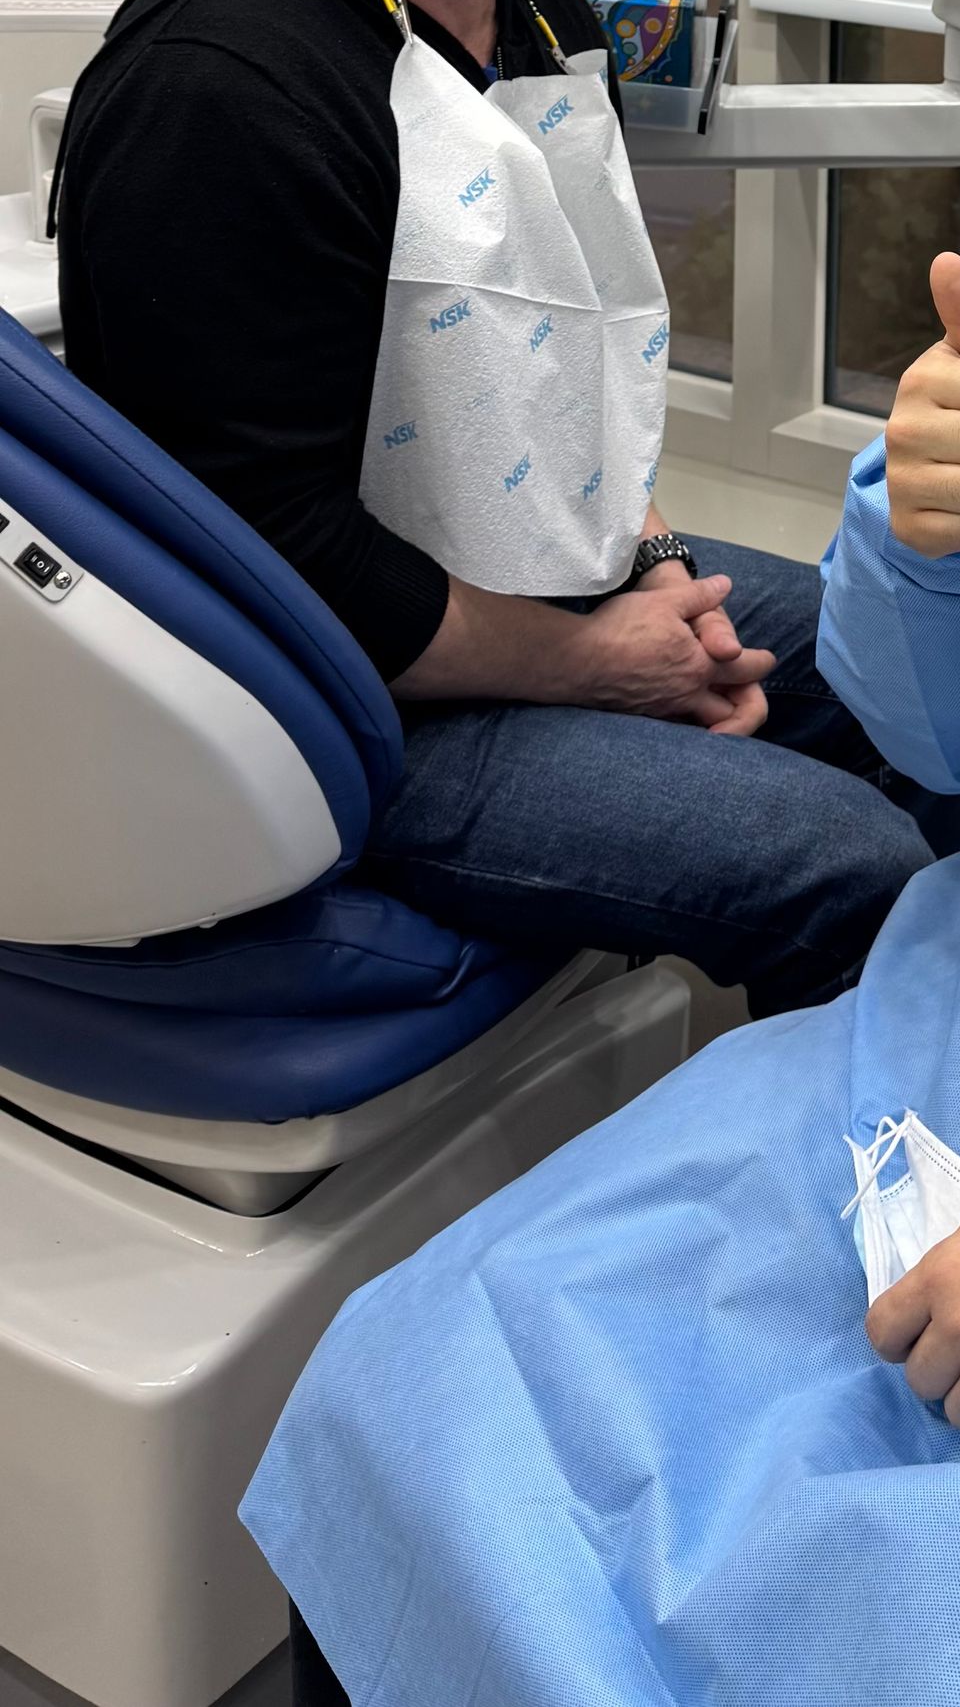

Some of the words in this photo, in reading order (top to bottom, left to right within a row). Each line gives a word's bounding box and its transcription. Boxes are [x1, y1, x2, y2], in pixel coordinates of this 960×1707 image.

[537, 95, 575, 135] NSK
[457, 166, 496, 208] NSK
[429, 296, 472, 334] NSK
[529, 313, 553, 353] NSK
[641, 320, 669, 364] NSK
[383, 420, 418, 450] NSK
[503, 450, 531, 493] NSK
[582, 461, 603, 501] NS
